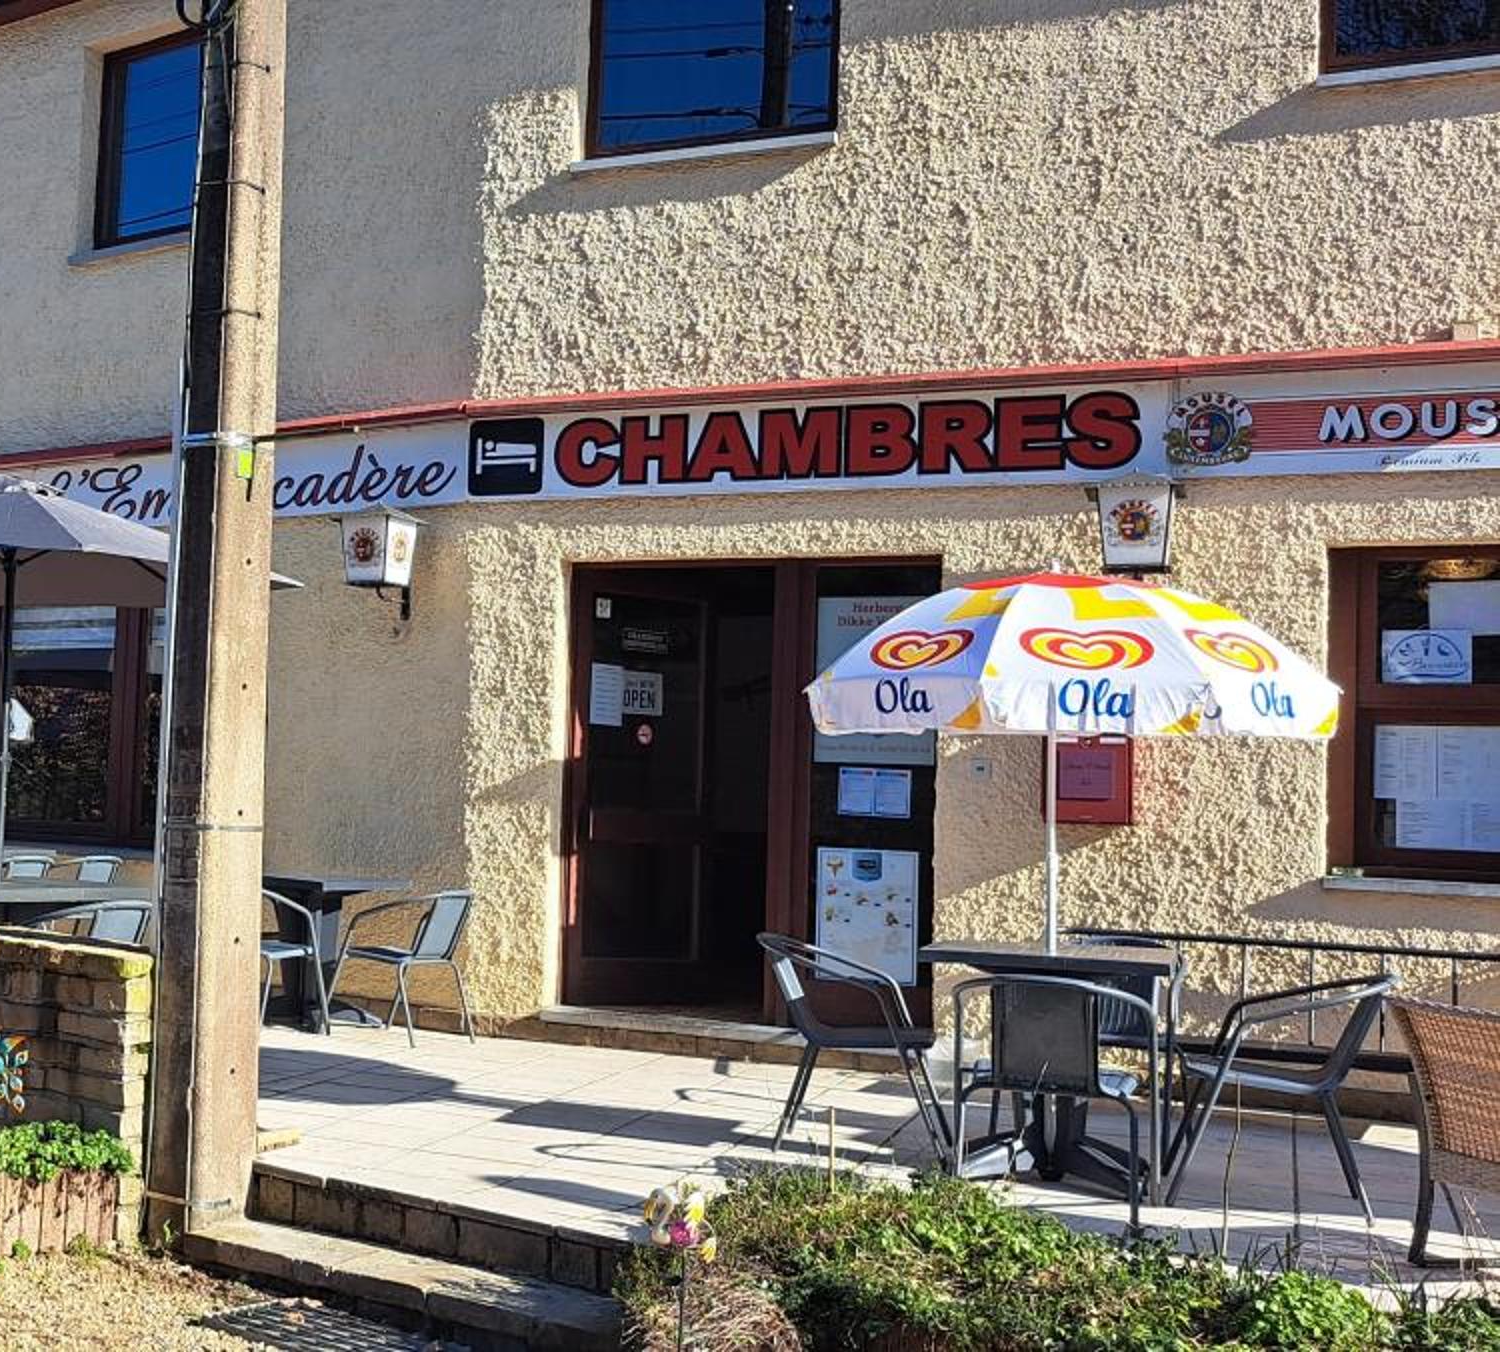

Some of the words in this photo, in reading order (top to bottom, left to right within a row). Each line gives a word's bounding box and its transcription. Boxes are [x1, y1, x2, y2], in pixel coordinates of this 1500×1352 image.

[1175, 391, 1246, 417] MOUSEL
[1318, 398, 1500, 443] MOUS
[554, 391, 1143, 487] CHAMBRES
[623, 689, 655, 709] OPEN
[875, 677, 933, 714] Ola
[1058, 678, 1134, 718] Ola
[1251, 681, 1296, 719] Ola
